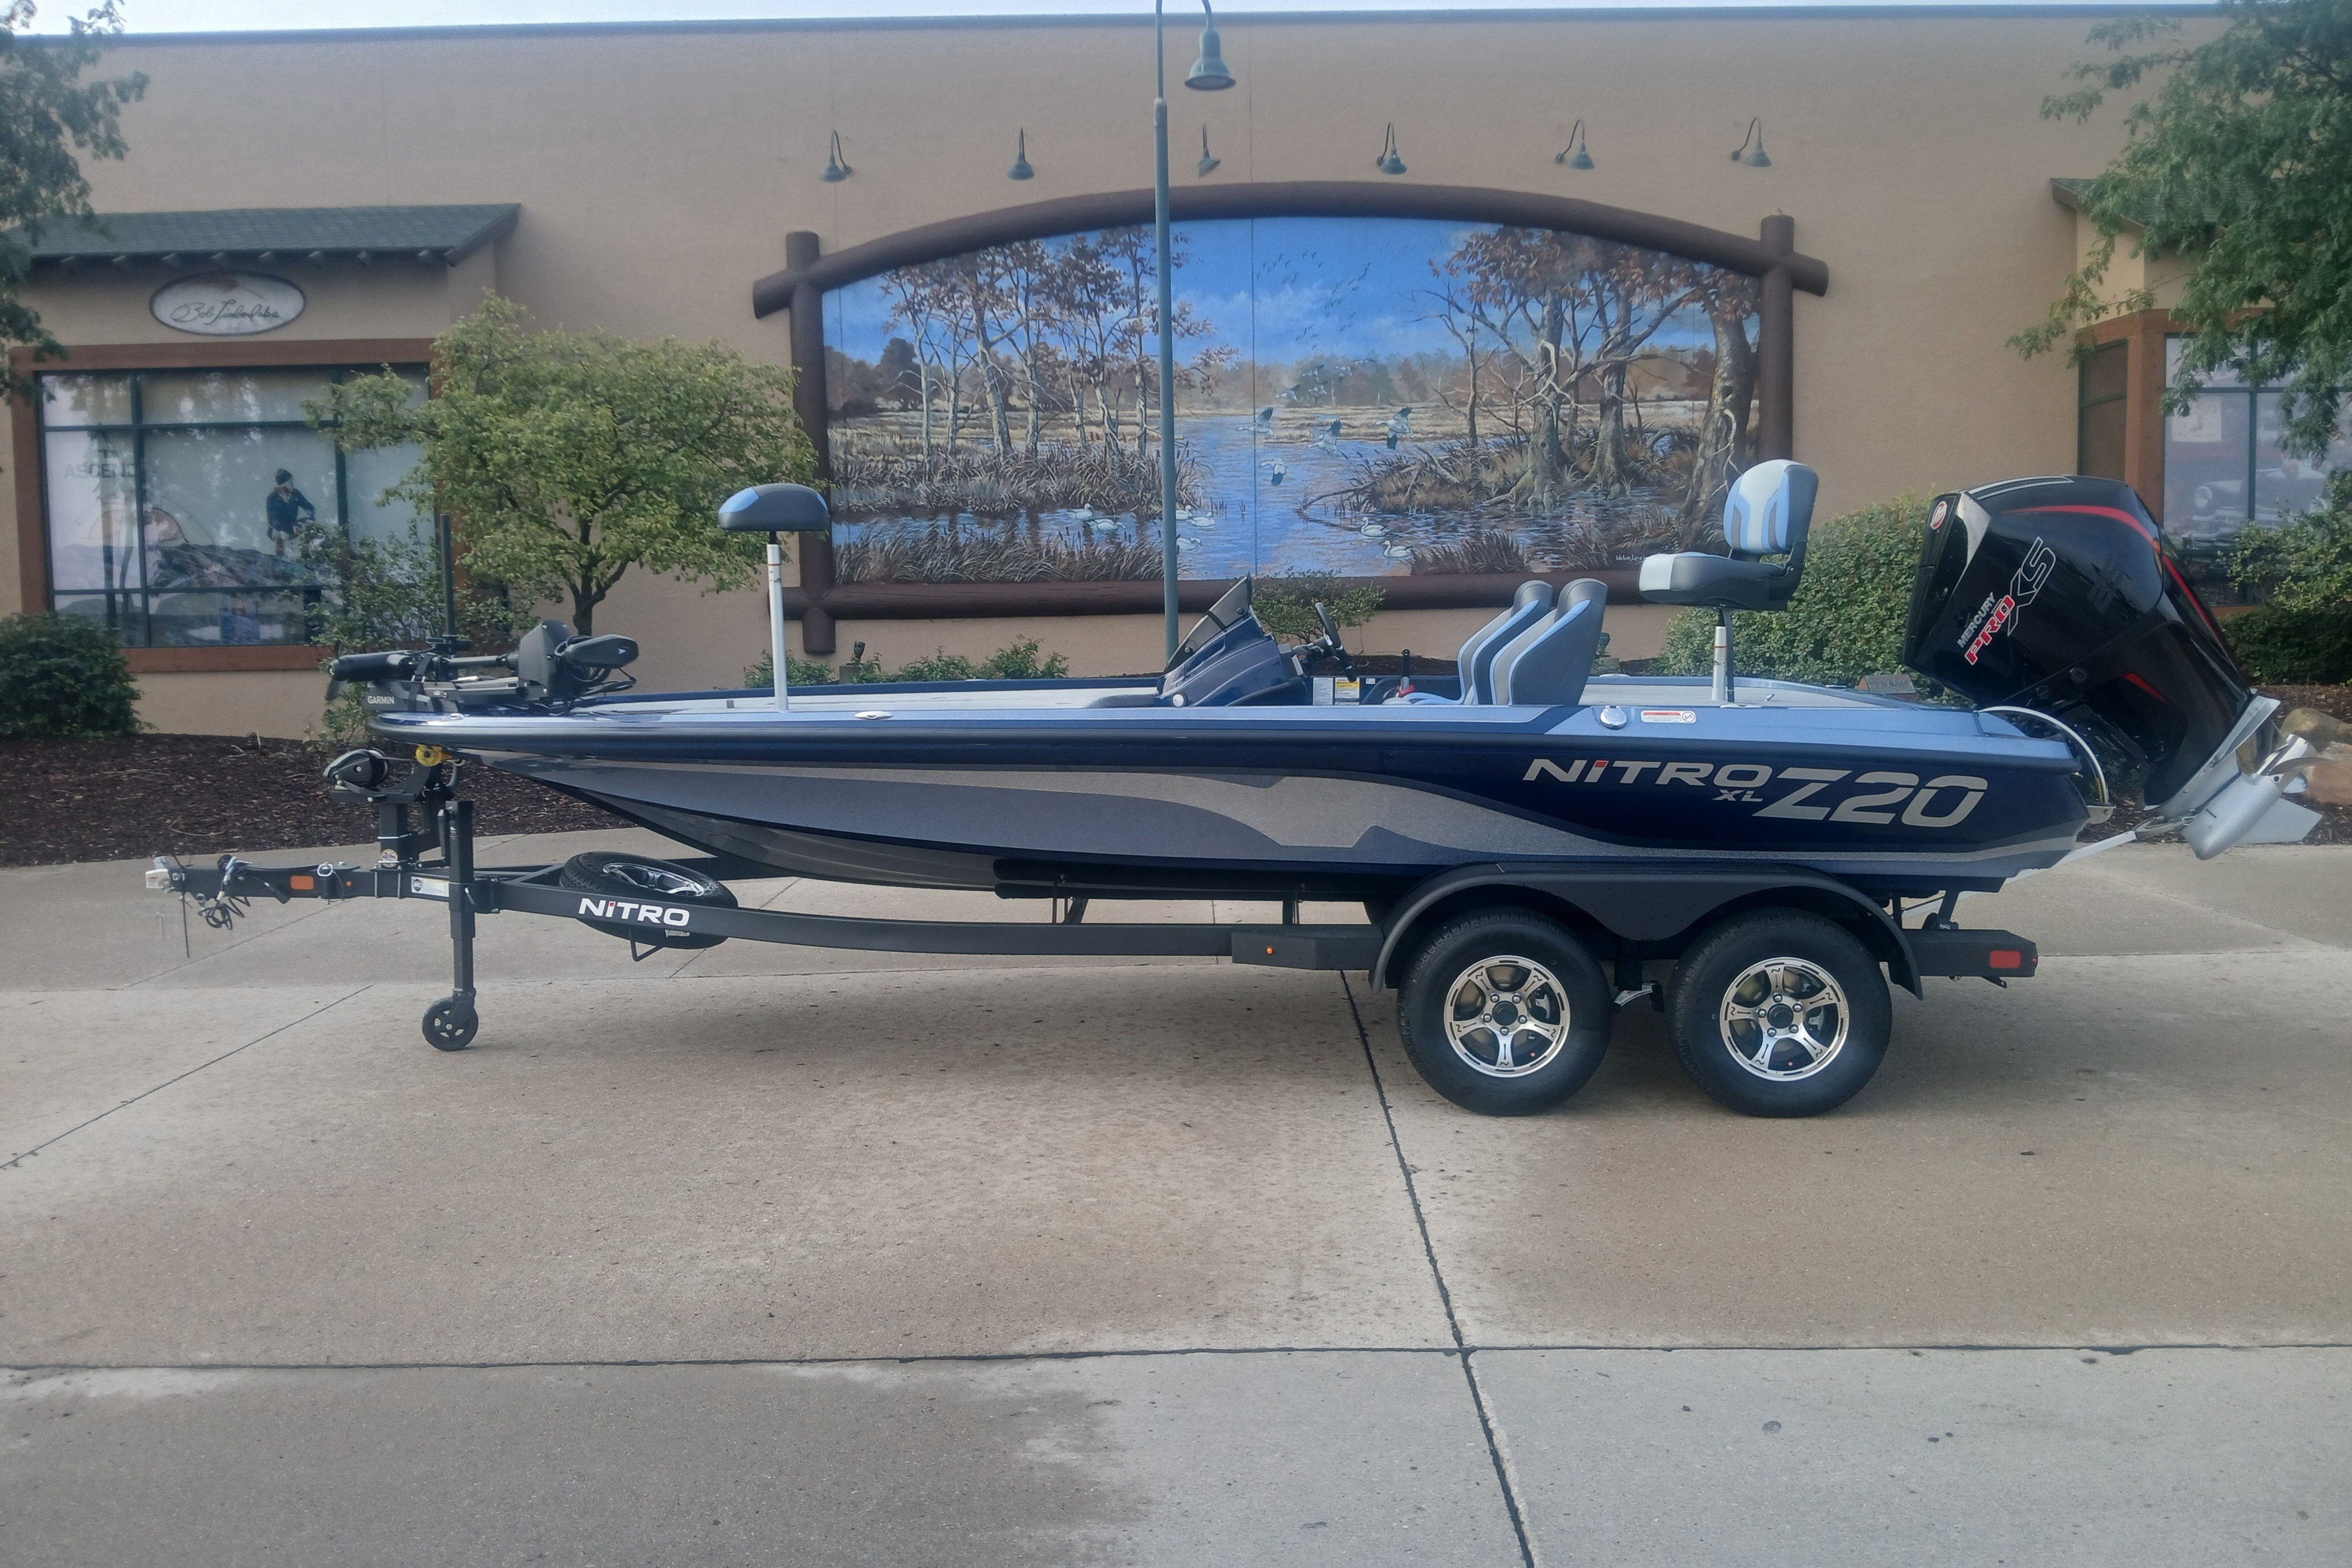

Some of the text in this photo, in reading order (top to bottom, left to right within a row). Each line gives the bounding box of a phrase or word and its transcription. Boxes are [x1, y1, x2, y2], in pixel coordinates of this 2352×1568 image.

[171, 302, 214, 323] Bob
[1957, 591, 1996, 649] MERCURY
[1964, 536, 2056, 666] PRO XS
[367, 695, 395, 704] GARMIN
[1712, 789, 1763, 802] XL
[1751, 767, 1989, 827] Z20
